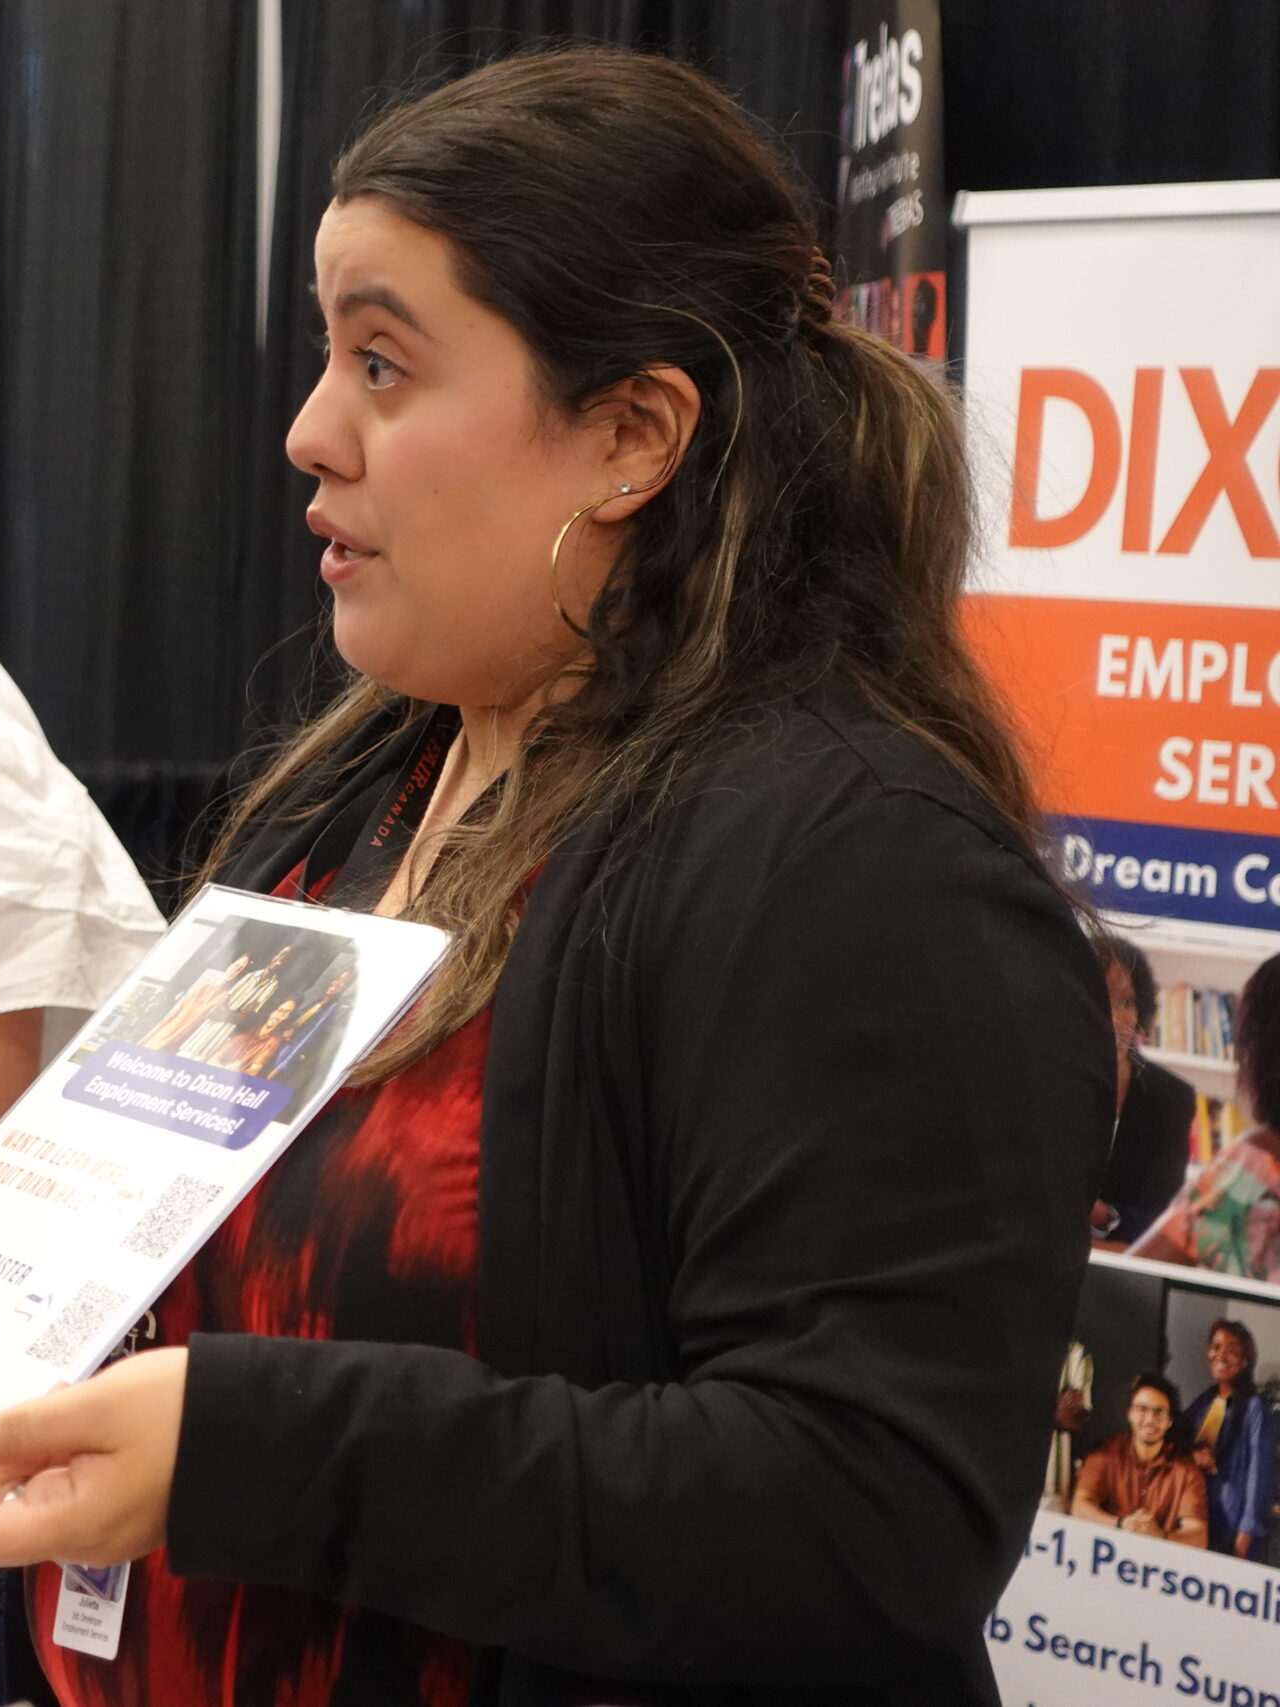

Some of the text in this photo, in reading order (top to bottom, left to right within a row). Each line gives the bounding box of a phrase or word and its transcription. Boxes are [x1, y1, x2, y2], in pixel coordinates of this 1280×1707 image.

[1009, 366, 1280, 560] DIX
[1096, 633, 1280, 708] EMPL
[1153, 736, 1278, 809] SER
[371, 782, 415, 848] CANADA
[1062, 834, 1218, 899] Dream
[83, 1075, 246, 1136] Employment Services!
[106, 1050, 270, 1110] Welcome to Dixon Hall
[0, 1128, 41, 1154] WANT
[33, 1139, 56, 1160] TO
[16, 1171, 60, 1200] DIXON
[1024, 1613, 1163, 1686] Search
